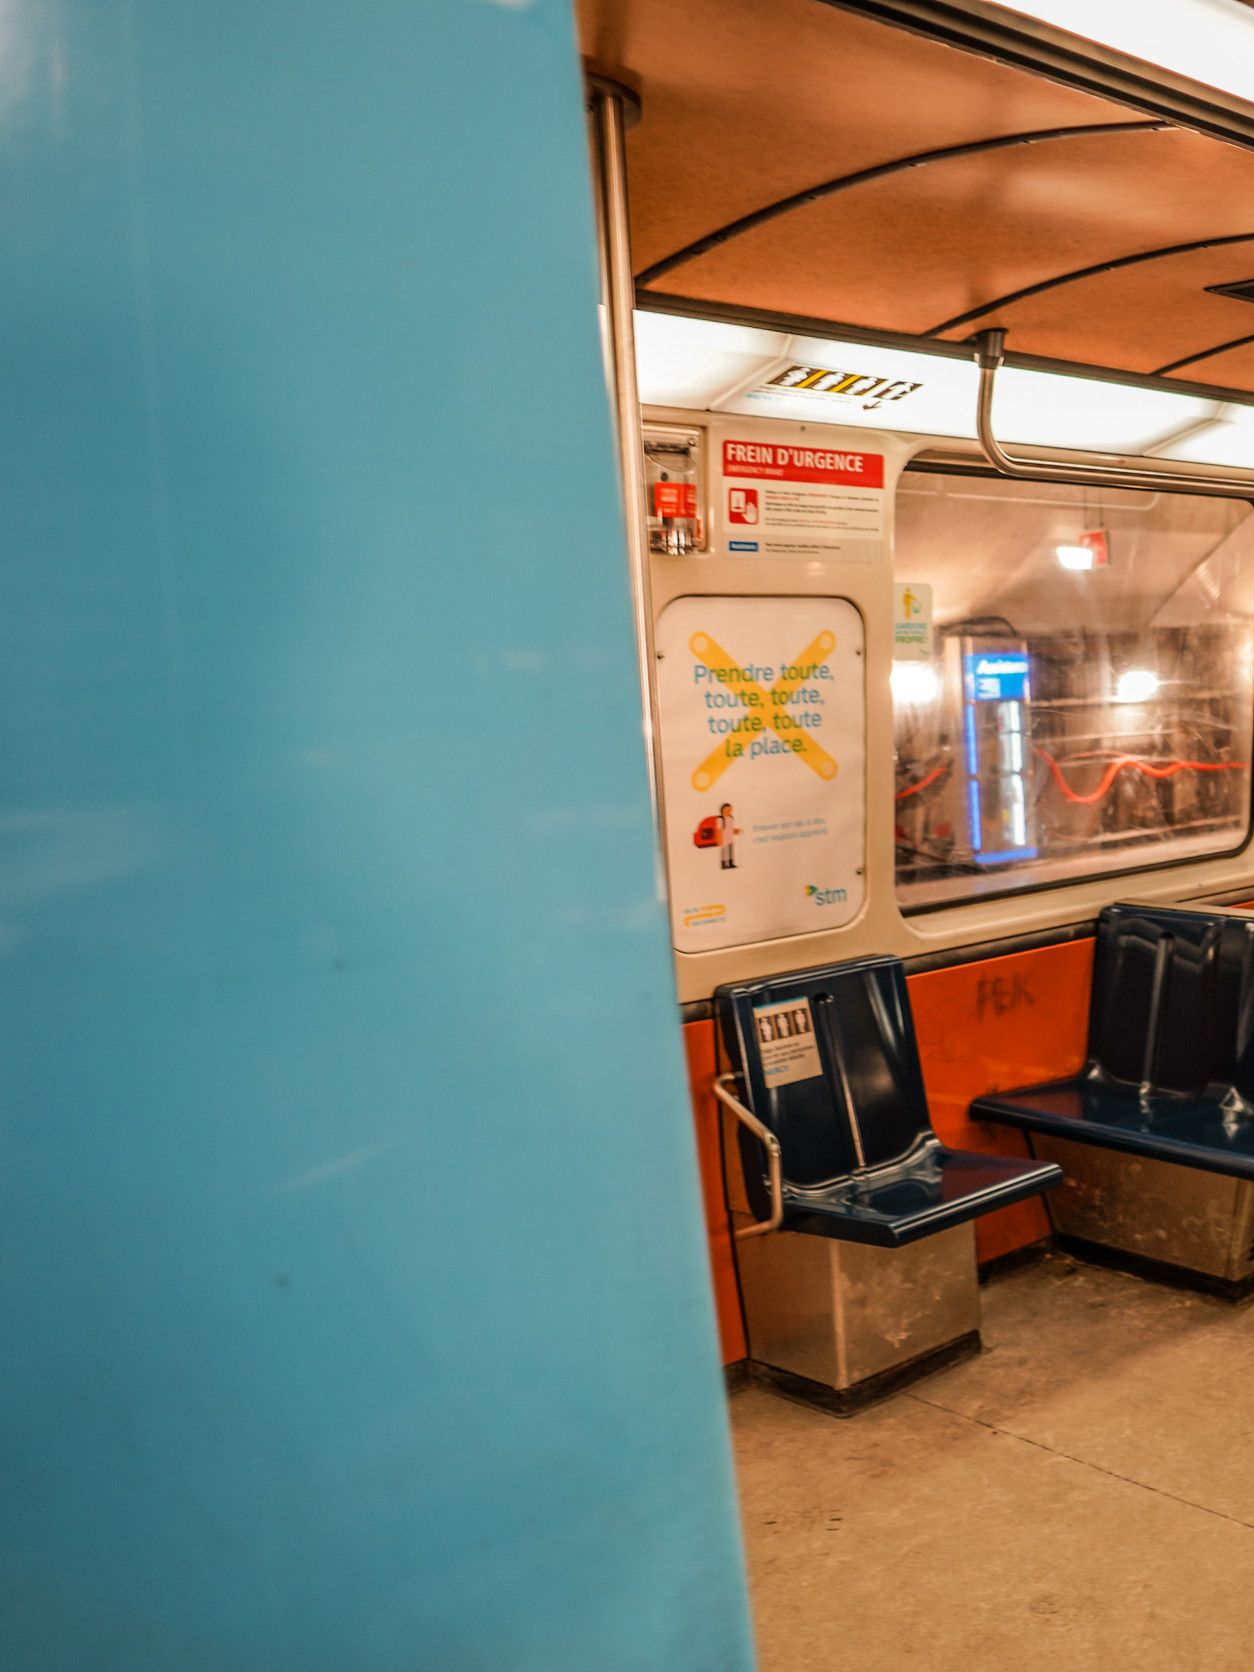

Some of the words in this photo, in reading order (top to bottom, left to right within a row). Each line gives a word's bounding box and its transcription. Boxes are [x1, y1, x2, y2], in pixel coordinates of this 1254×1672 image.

[727, 443, 772, 465] FREIN
[777, 448, 864, 473] D'URGENCE
[693, 662, 775, 684] Prendre
[780, 661, 834, 681] toute,
[704, 689, 765, 709] toute,
[771, 686, 825, 706] toute,
[707, 714, 767, 734] toute,
[773, 711, 823, 730] toute
[725, 739, 744, 758] la
[750, 736, 807, 760] place.
[815, 887, 847, 907] stm
